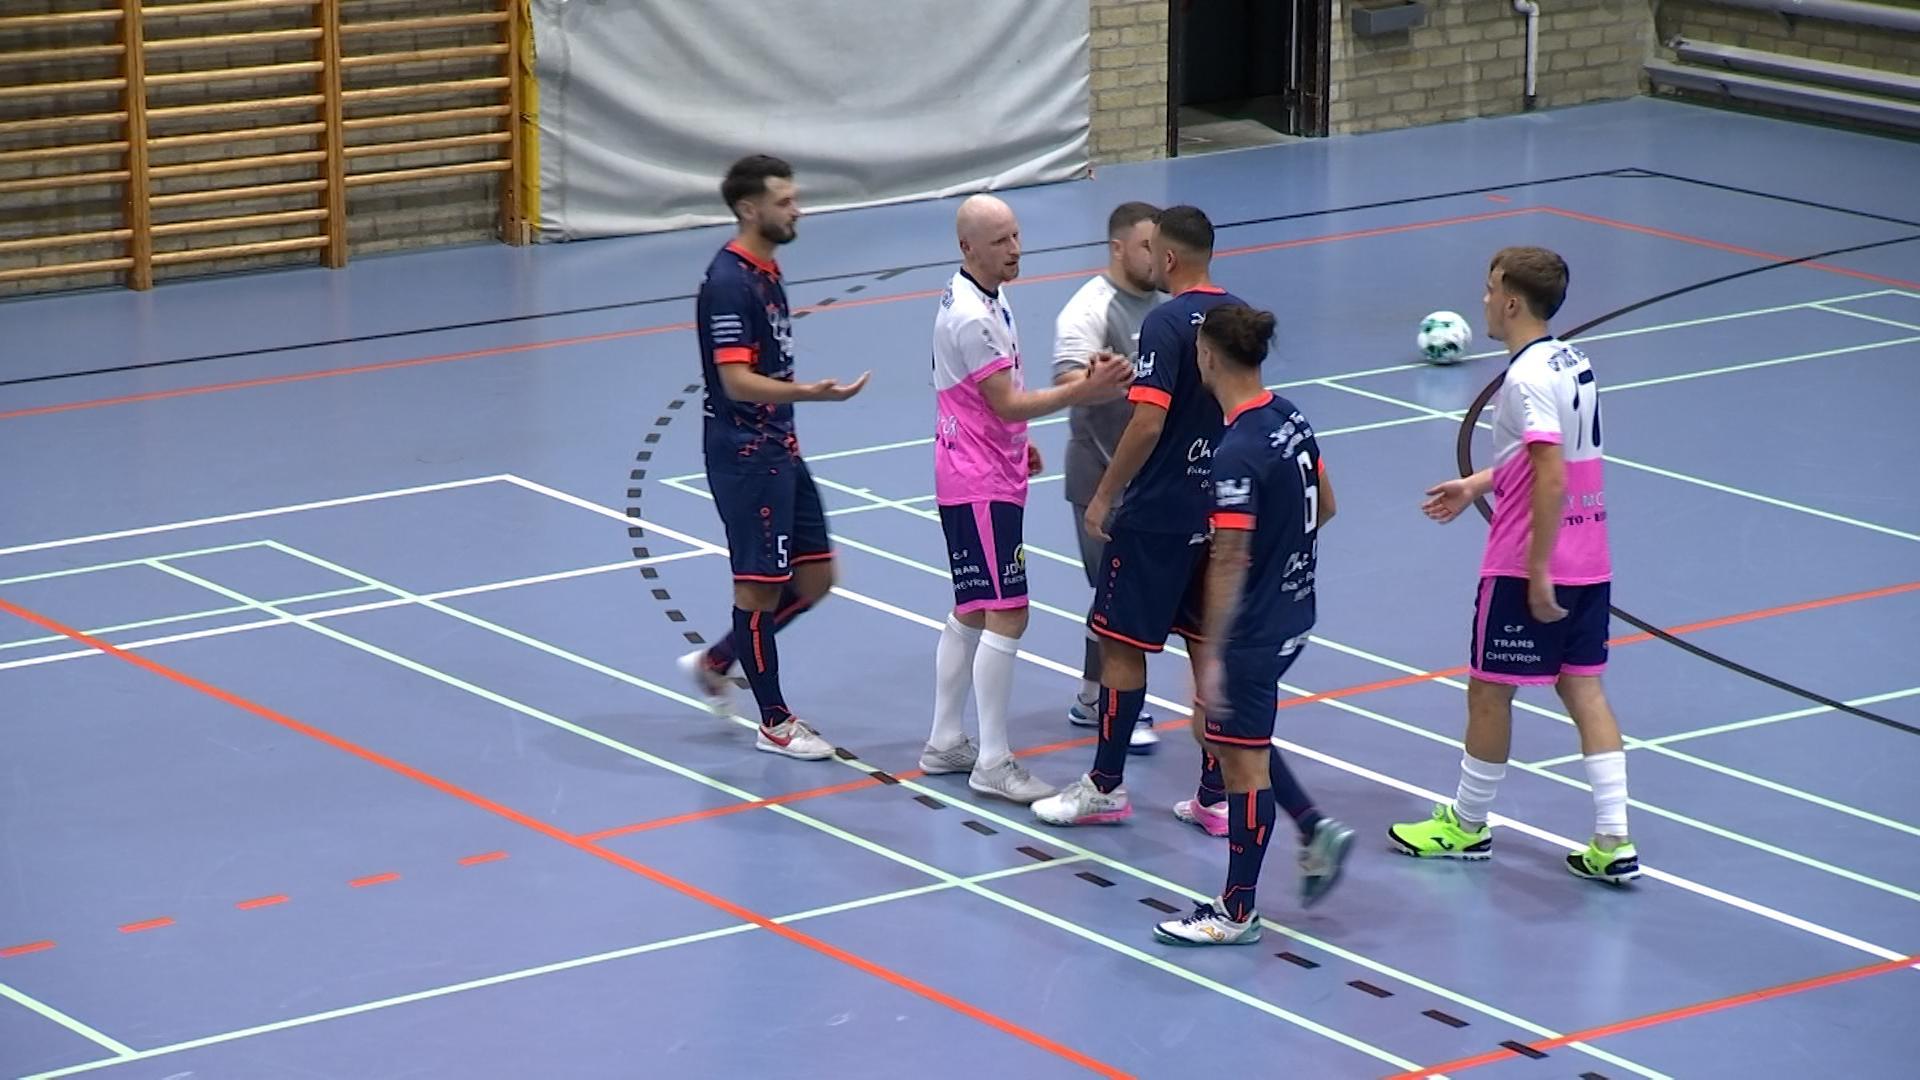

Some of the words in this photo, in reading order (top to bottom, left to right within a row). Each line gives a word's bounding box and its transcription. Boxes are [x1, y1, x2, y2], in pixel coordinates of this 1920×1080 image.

[1297, 451, 1318, 534] 6
[777, 535, 789, 568] 5
[1493, 639, 1535, 649] TRANS
[1485, 651, 1542, 664] CHEVRON
